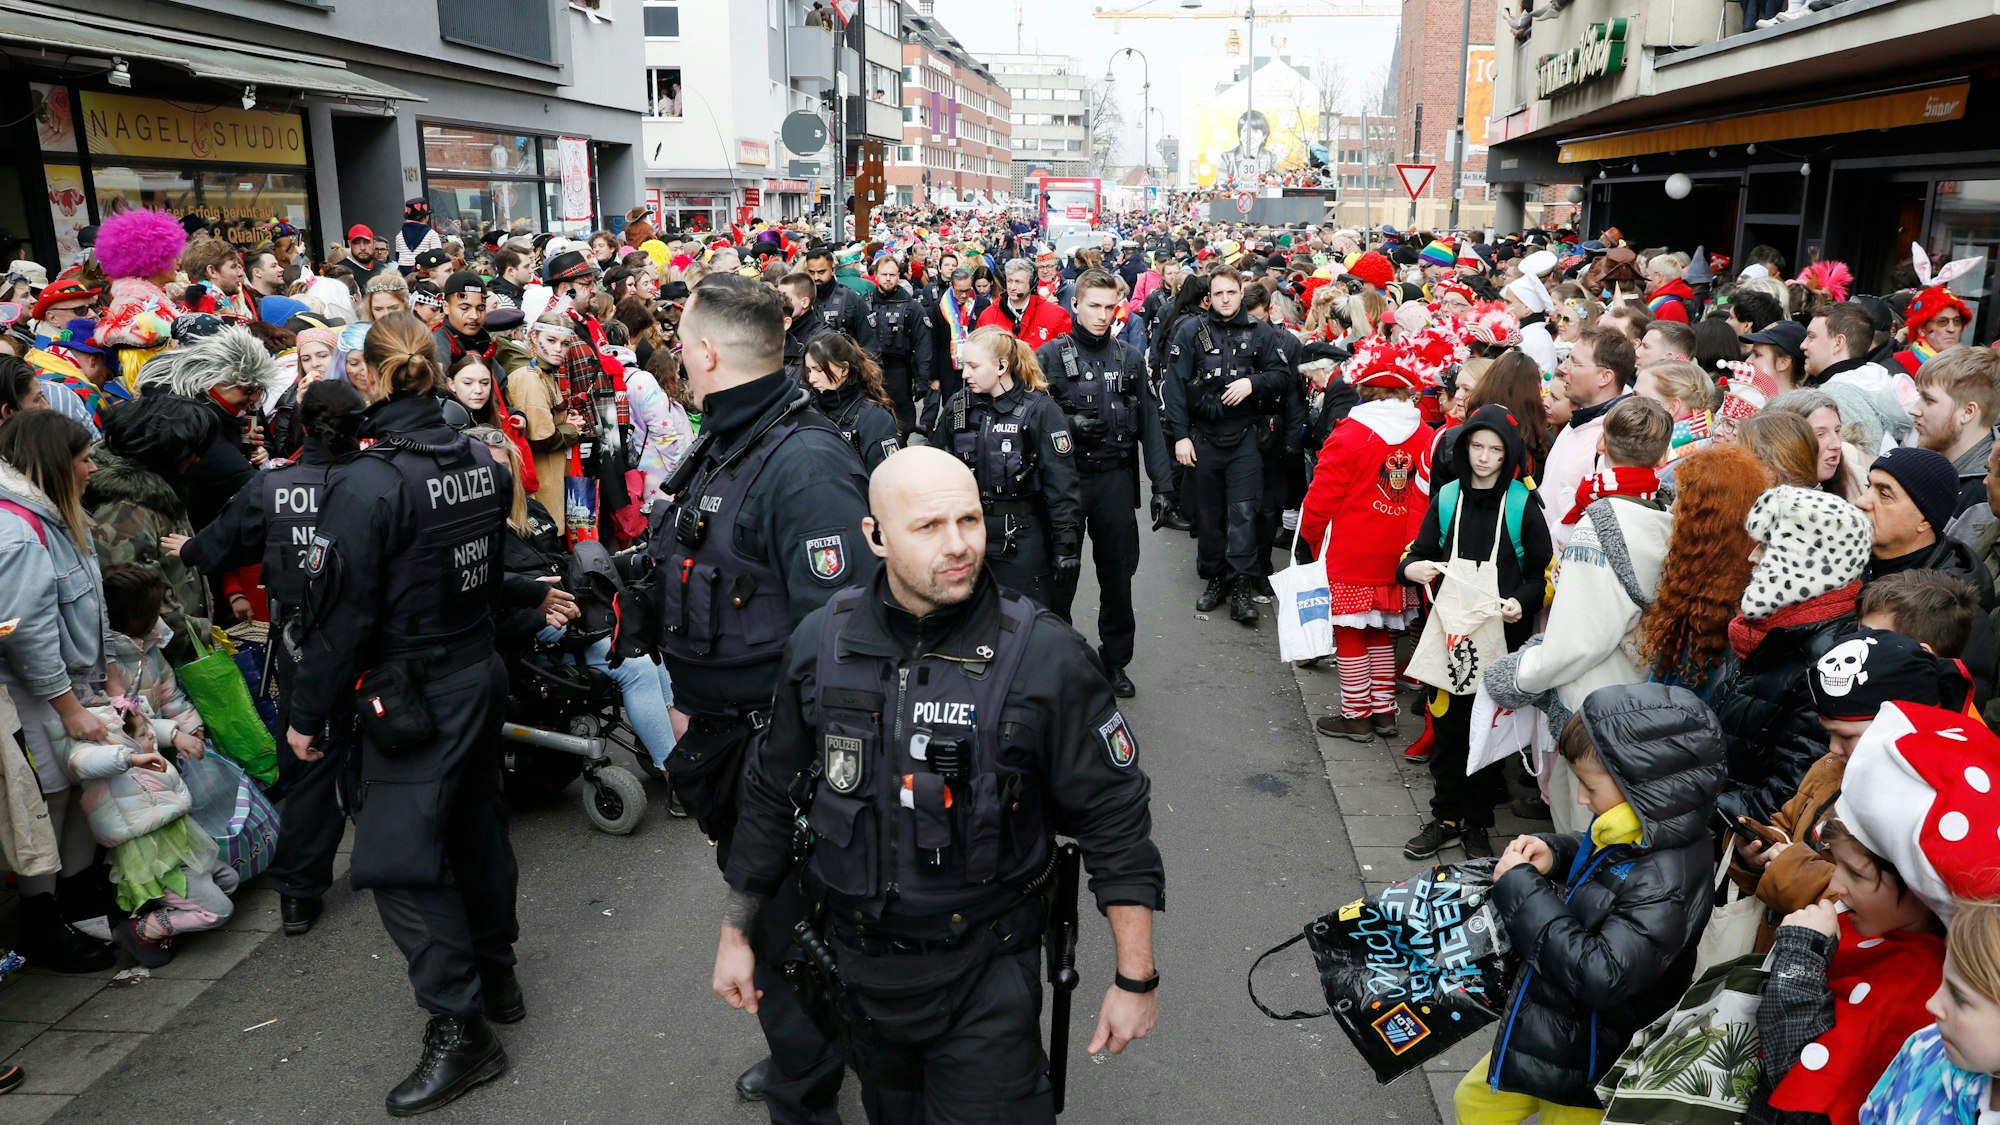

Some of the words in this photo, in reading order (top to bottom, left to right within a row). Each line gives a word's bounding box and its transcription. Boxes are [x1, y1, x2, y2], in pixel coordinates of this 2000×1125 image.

[90, 109, 188, 144] NAGEL
[213, 121, 299, 151] STUDIO
[1243, 164, 1255, 174] 30
[188, 205, 221, 222] Erfolg
[223, 205, 258, 218] beruht
[260, 206, 275, 218] auf
[992, 423, 1018, 433] POLIZEI
[426, 466, 496, 509] POLIZEI
[699, 495, 723, 512] OLIZEI
[454, 536, 489, 568] NRW
[808, 537, 840, 550] POLIZEI
[461, 563, 489, 591] 2611
[1297, 596, 1329, 610] ZEISS
[828, 737, 859, 752] POLIZEI
[1393, 1013, 1417, 1036] ALDI
